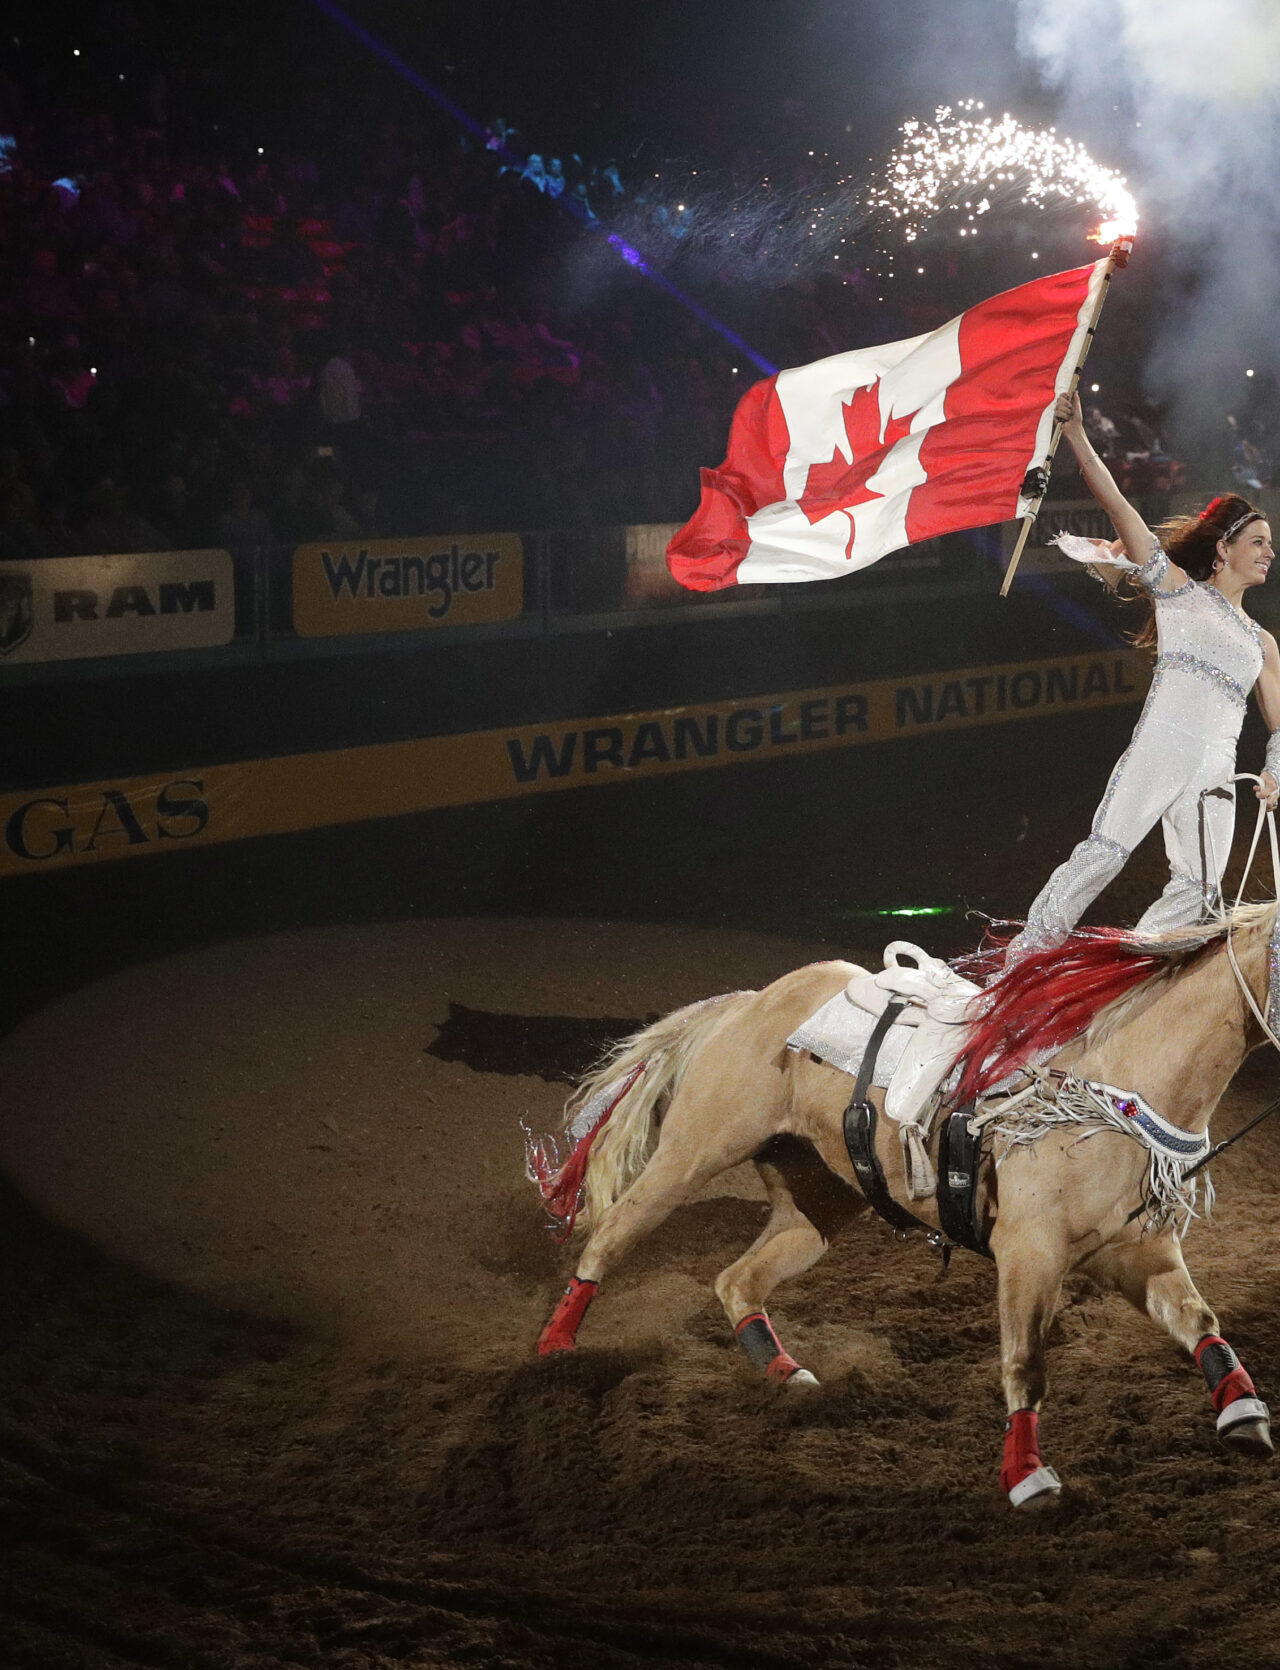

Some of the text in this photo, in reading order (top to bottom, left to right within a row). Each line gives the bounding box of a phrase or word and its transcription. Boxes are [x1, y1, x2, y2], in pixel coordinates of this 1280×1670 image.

[52, 579, 217, 624] RAM
[319, 543, 502, 618] Wrangler
[506, 660, 1135, 783] WRANGLER NATIONAL
[5, 779, 210, 861] GAS
